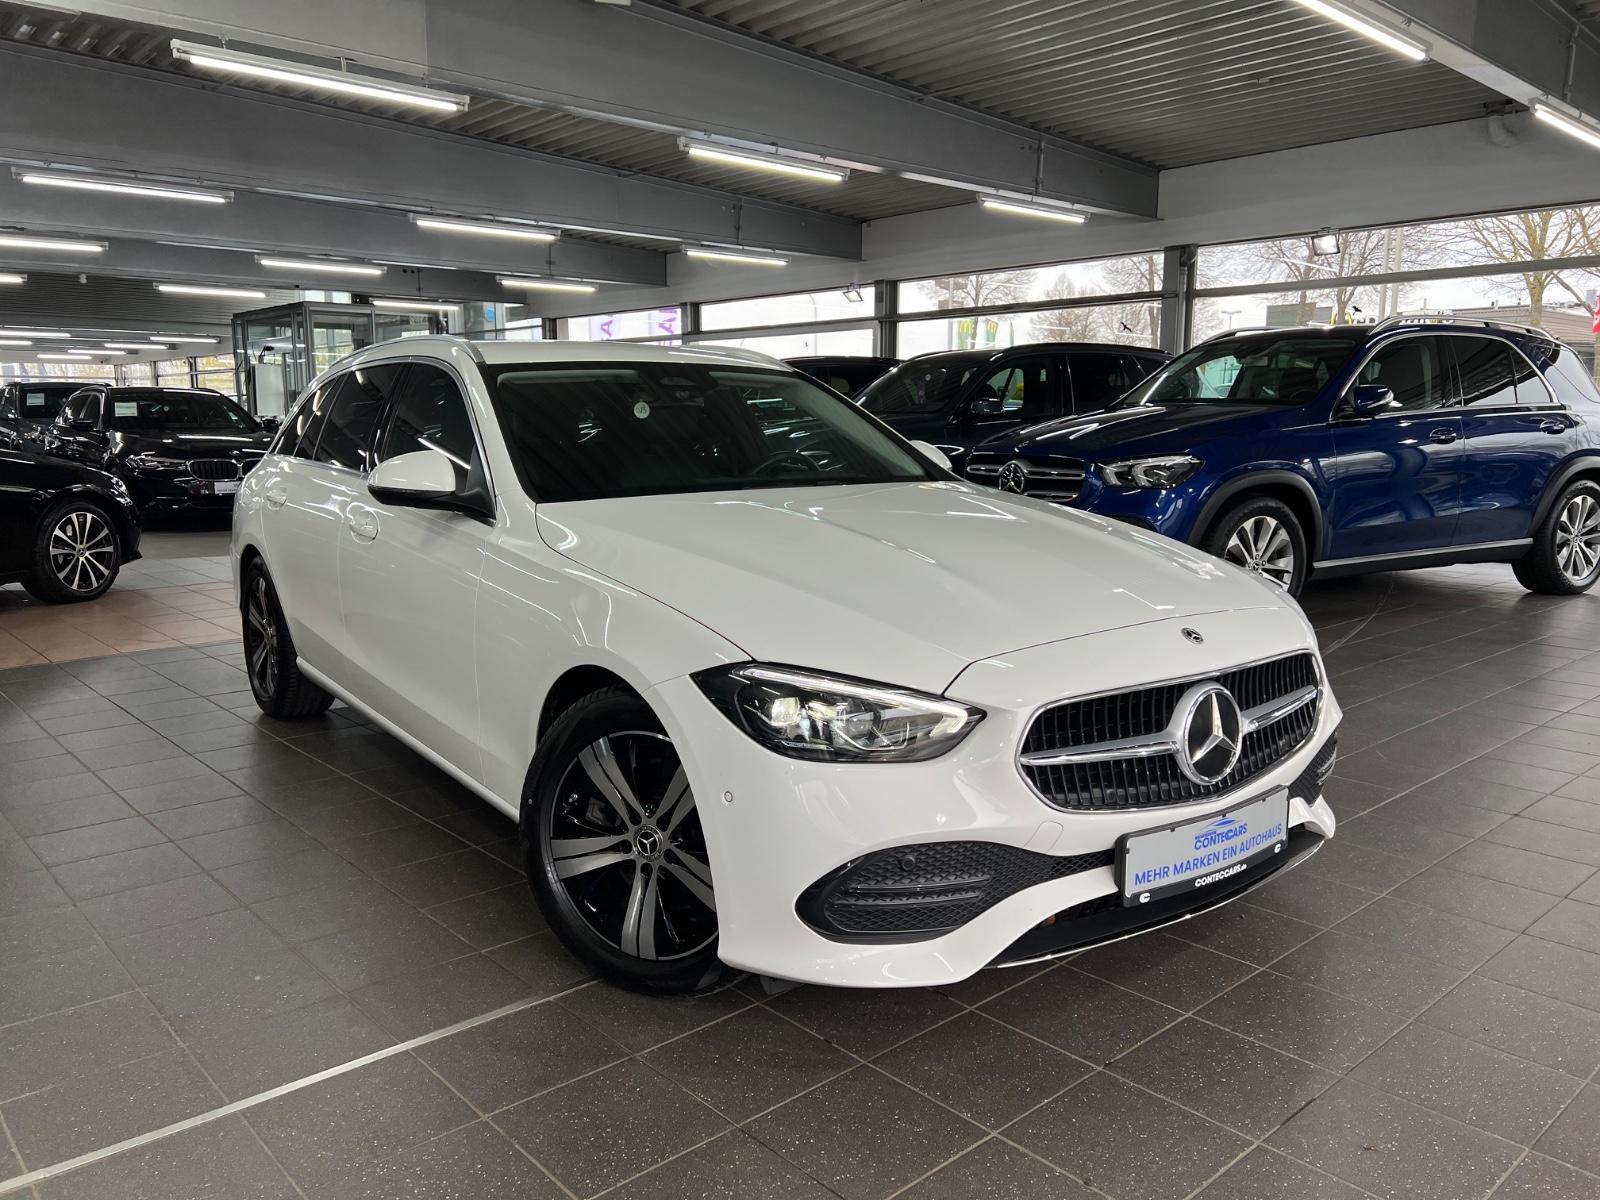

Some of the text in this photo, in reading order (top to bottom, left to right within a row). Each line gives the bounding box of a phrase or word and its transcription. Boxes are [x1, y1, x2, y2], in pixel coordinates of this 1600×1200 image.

[1134, 866, 1170, 886] MEHR
[1173, 851, 1220, 876] MARKEN
[1222, 844, 1238, 860] EIN
[1239, 824, 1282, 854] AUTOHAUS
